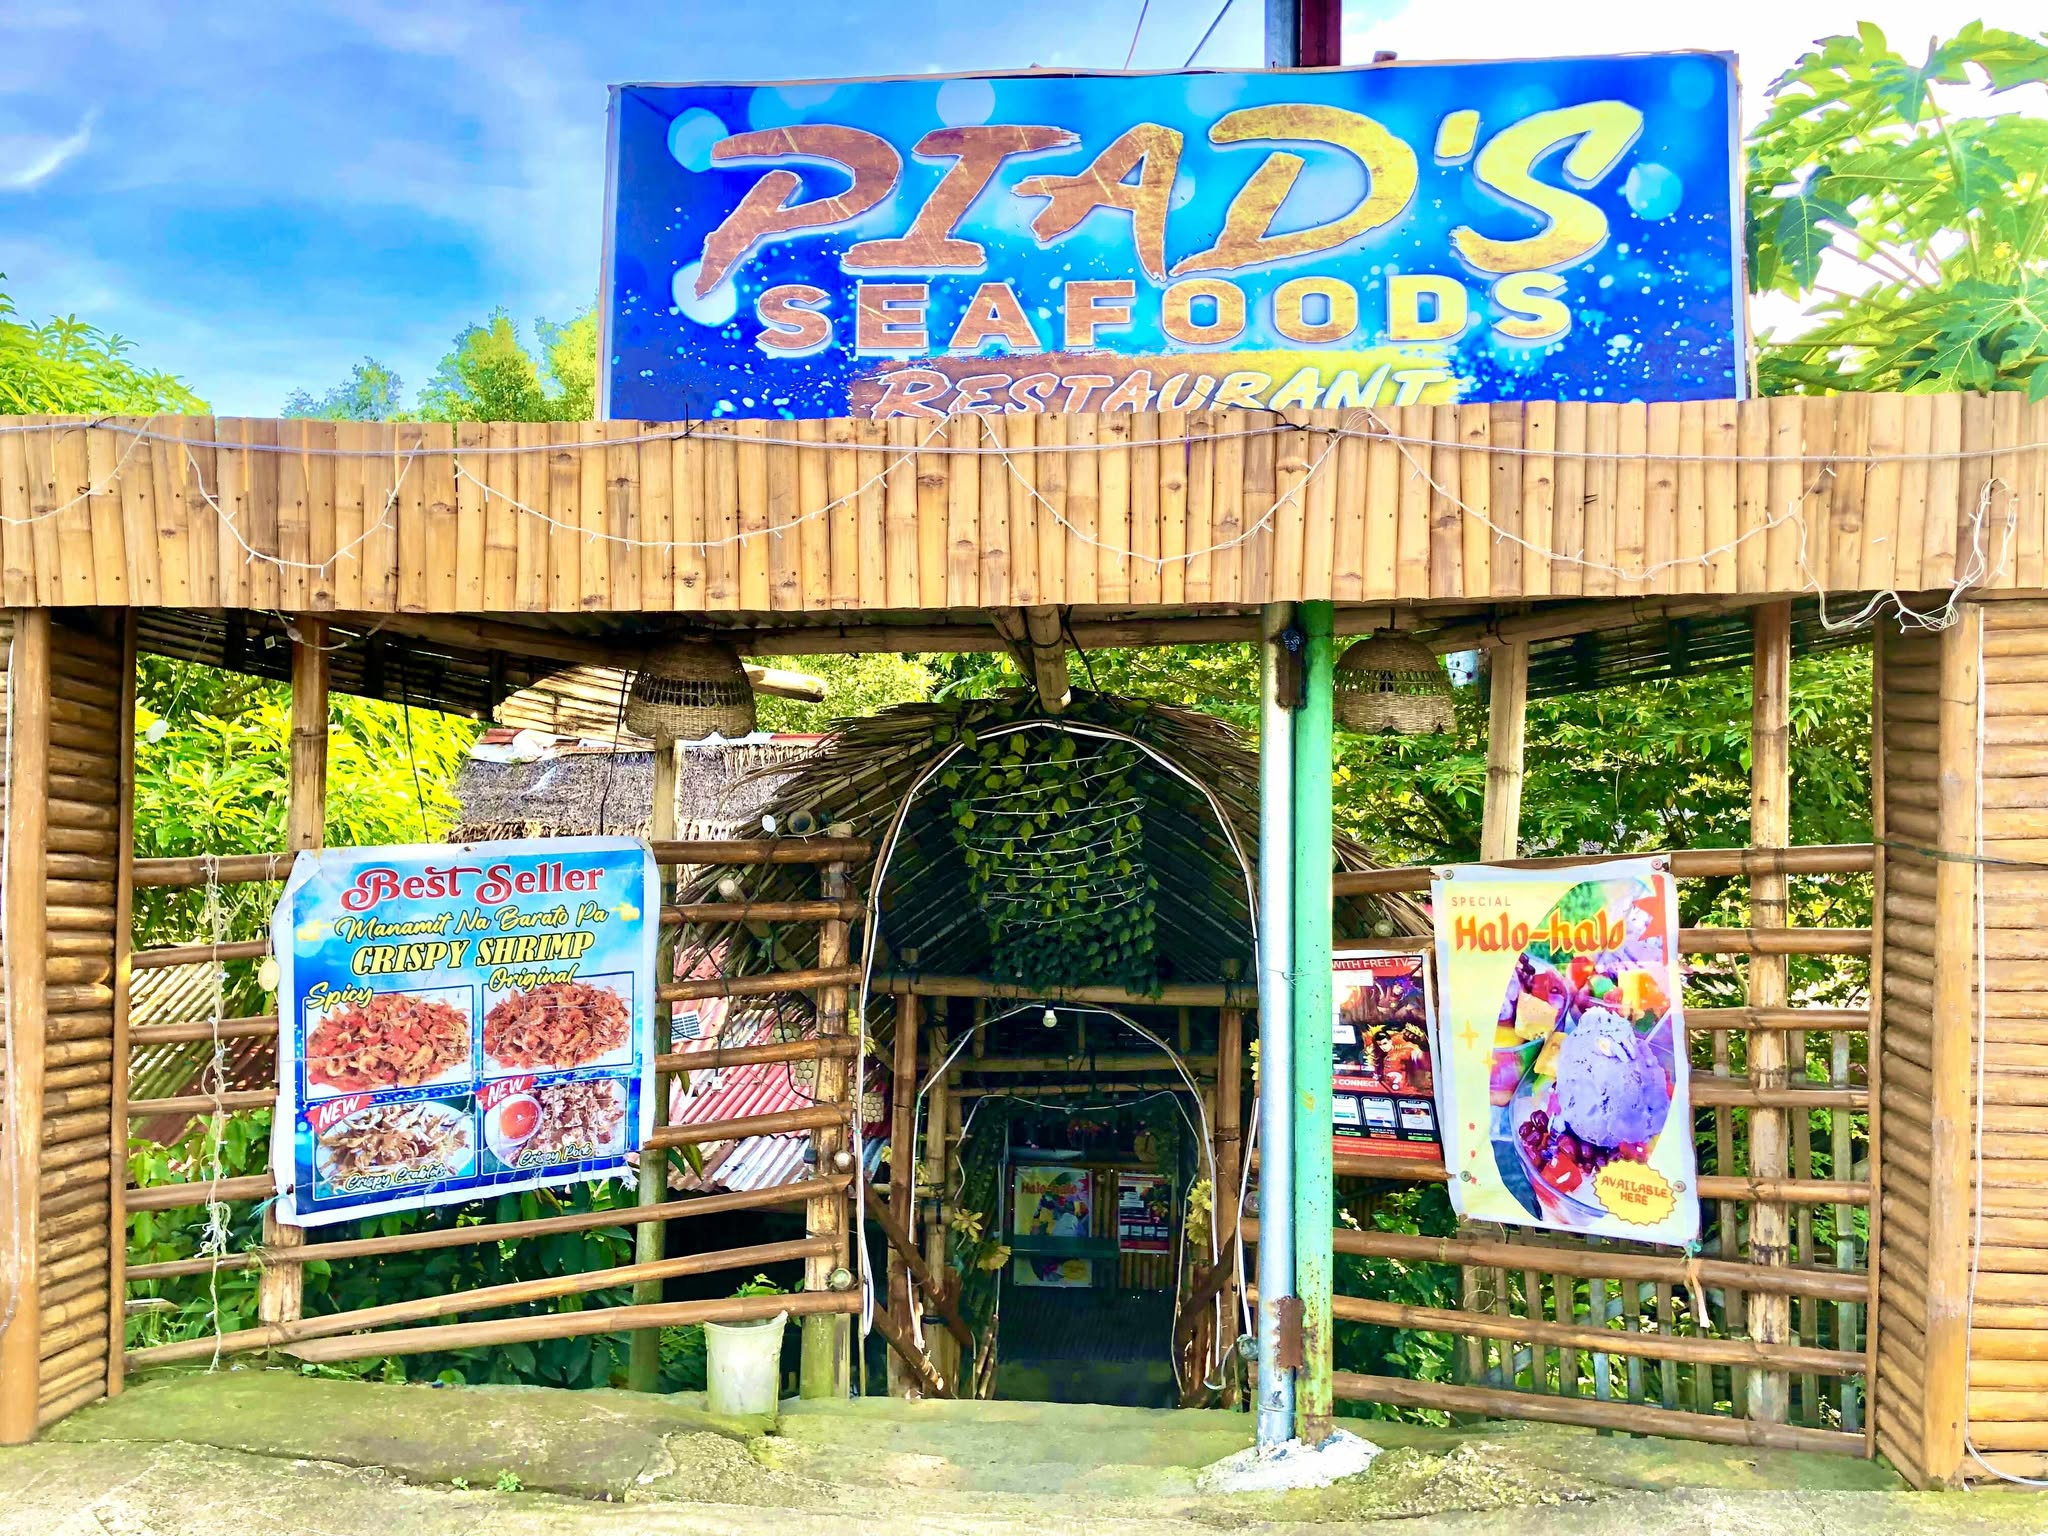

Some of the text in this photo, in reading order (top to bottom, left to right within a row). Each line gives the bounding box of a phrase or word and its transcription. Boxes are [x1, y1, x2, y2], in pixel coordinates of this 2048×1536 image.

[694, 100, 1645, 299] PIAD'S
[755, 271, 1572, 359] SEAFOODS
[871, 364, 1450, 419] RESTAURANT
[341, 862, 604, 911] Best Seller
[1451, 896, 1511, 907] SPECIAL
[335, 900, 608, 943] Manamit Na Barato Pa
[1454, 909, 1628, 955] Halo-halo
[352, 931, 595, 975] CRISPY SHRIMP
[1332, 957, 1409, 969] WITH FREE TV
[488, 964, 579, 993] Original
[307, 981, 374, 1012] Spicy
[487, 1076, 526, 1106] NEW
[1338, 1079, 1379, 1087] CONNECT
[318, 1096, 359, 1129] NEW
[345, 1173, 391, 1191] Crispy
[1601, 1176, 1668, 1198] AVAILABLE
[1621, 1192, 1648, 1206] HERE
